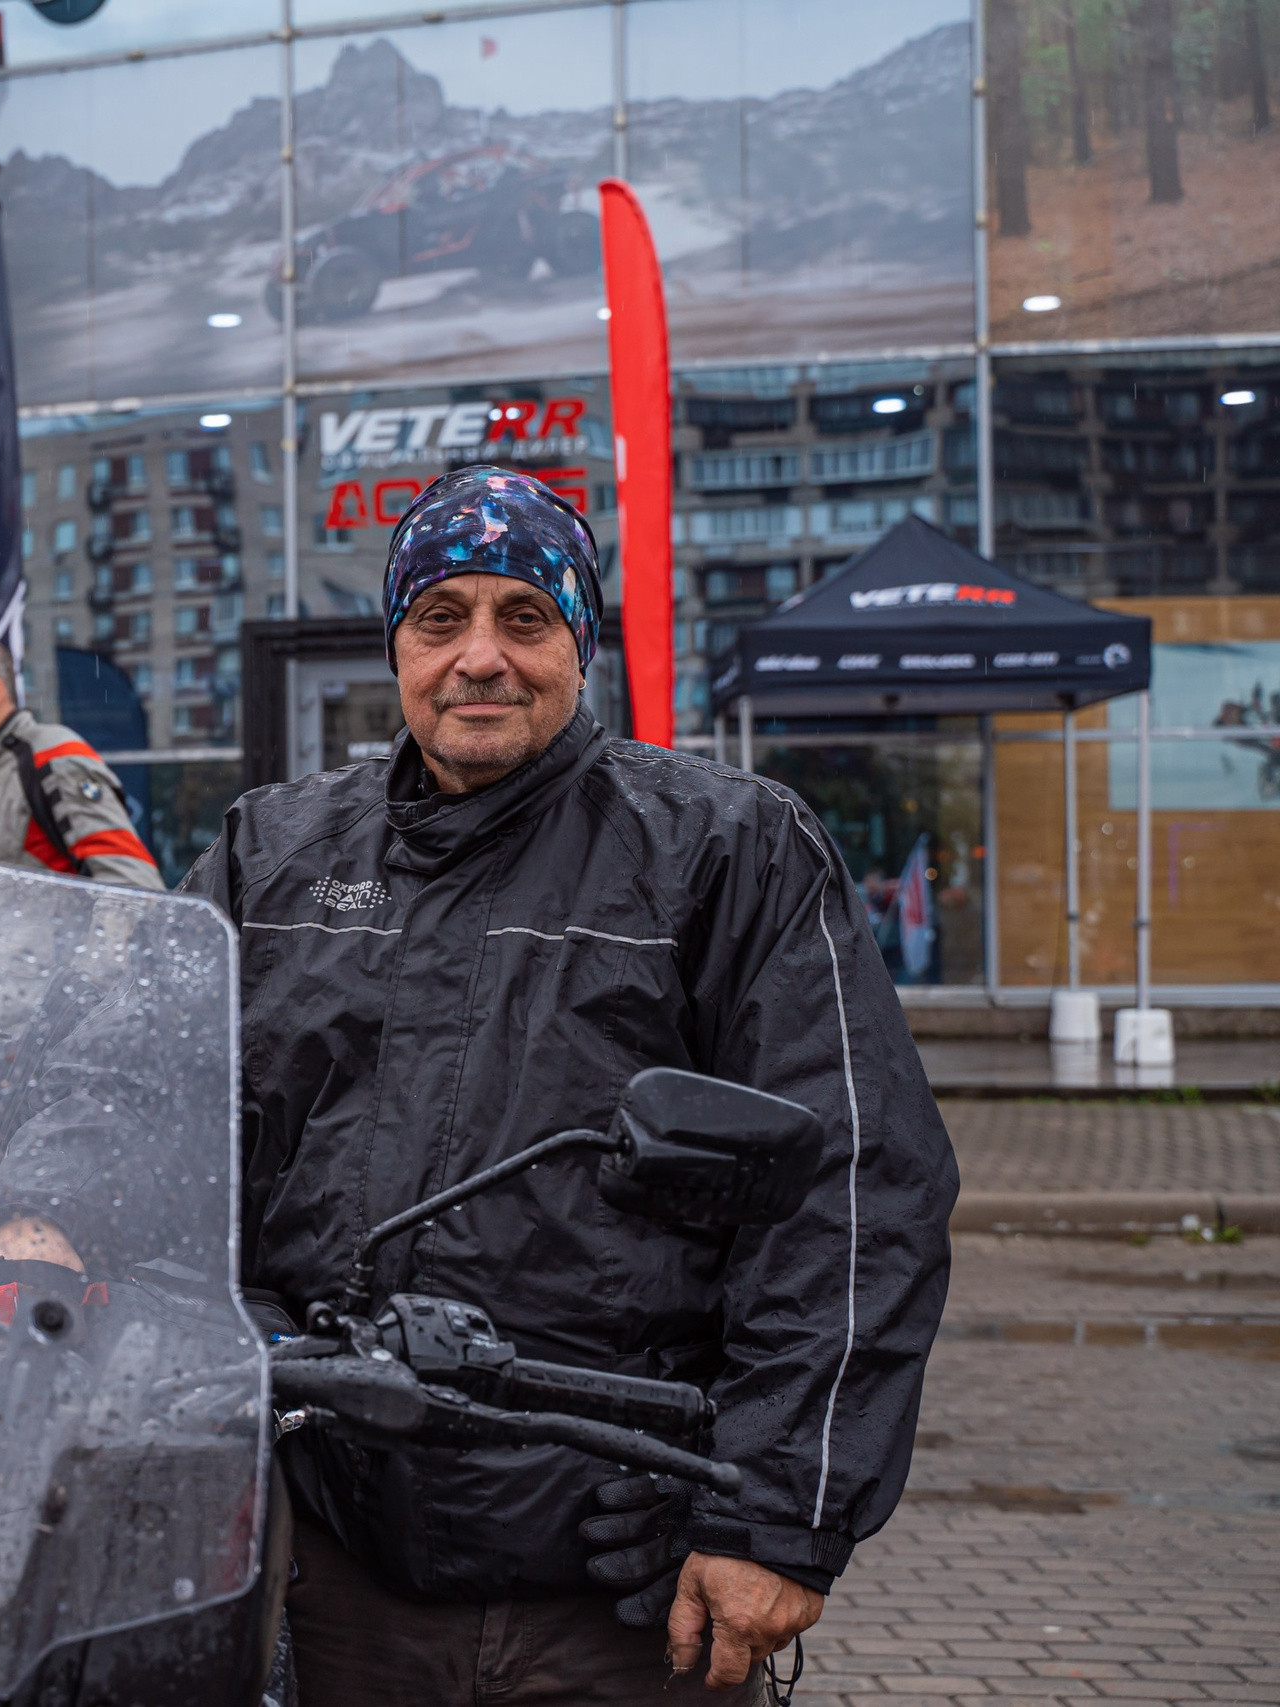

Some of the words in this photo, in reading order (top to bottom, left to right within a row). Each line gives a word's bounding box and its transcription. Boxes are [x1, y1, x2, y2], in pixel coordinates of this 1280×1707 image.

[320, 399, 586, 453] VETERR
[331, 880, 373, 894] OXFORD
[324, 897, 367, 911] SEAL
